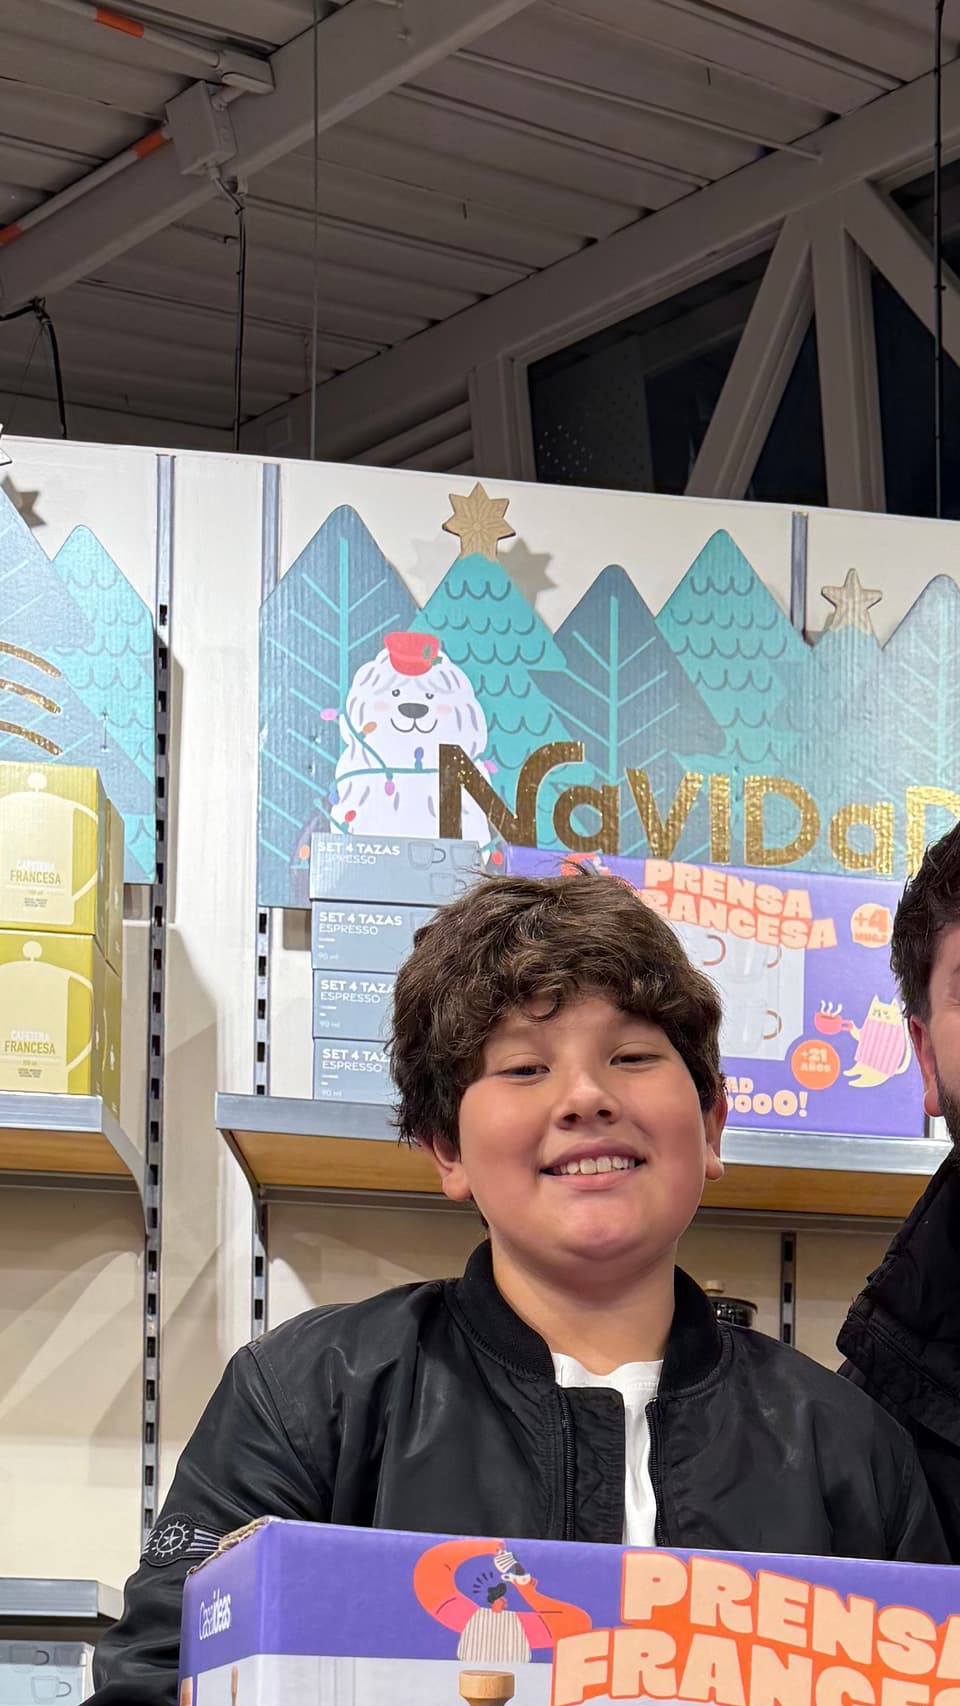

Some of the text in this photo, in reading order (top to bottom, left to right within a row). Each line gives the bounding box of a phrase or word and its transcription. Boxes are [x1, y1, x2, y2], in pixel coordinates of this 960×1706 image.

[318, 842, 401, 856] SET 4 TAZAS
[318, 854, 377, 865] ESPRESSO
[10, 870, 61, 884] FRANCESA
[644, 858, 813, 920] PRENSA
[319, 912, 403, 926] SET 4 TAZAS
[640, 888, 838, 950] RANCESA
[853, 909, 888, 932] +4
[319, 924, 378, 935] ESPRESSO
[320, 980, 396, 994] SET 4 TAZA
[320, 991, 381, 1004] ESPRESSO
[4, 1040, 56, 1055] FRANCESA
[322, 1048, 391, 1063] SET 4 TAZ
[801, 1048, 828, 1063] +21
[322, 1060, 383, 1073] ESPRESSO
